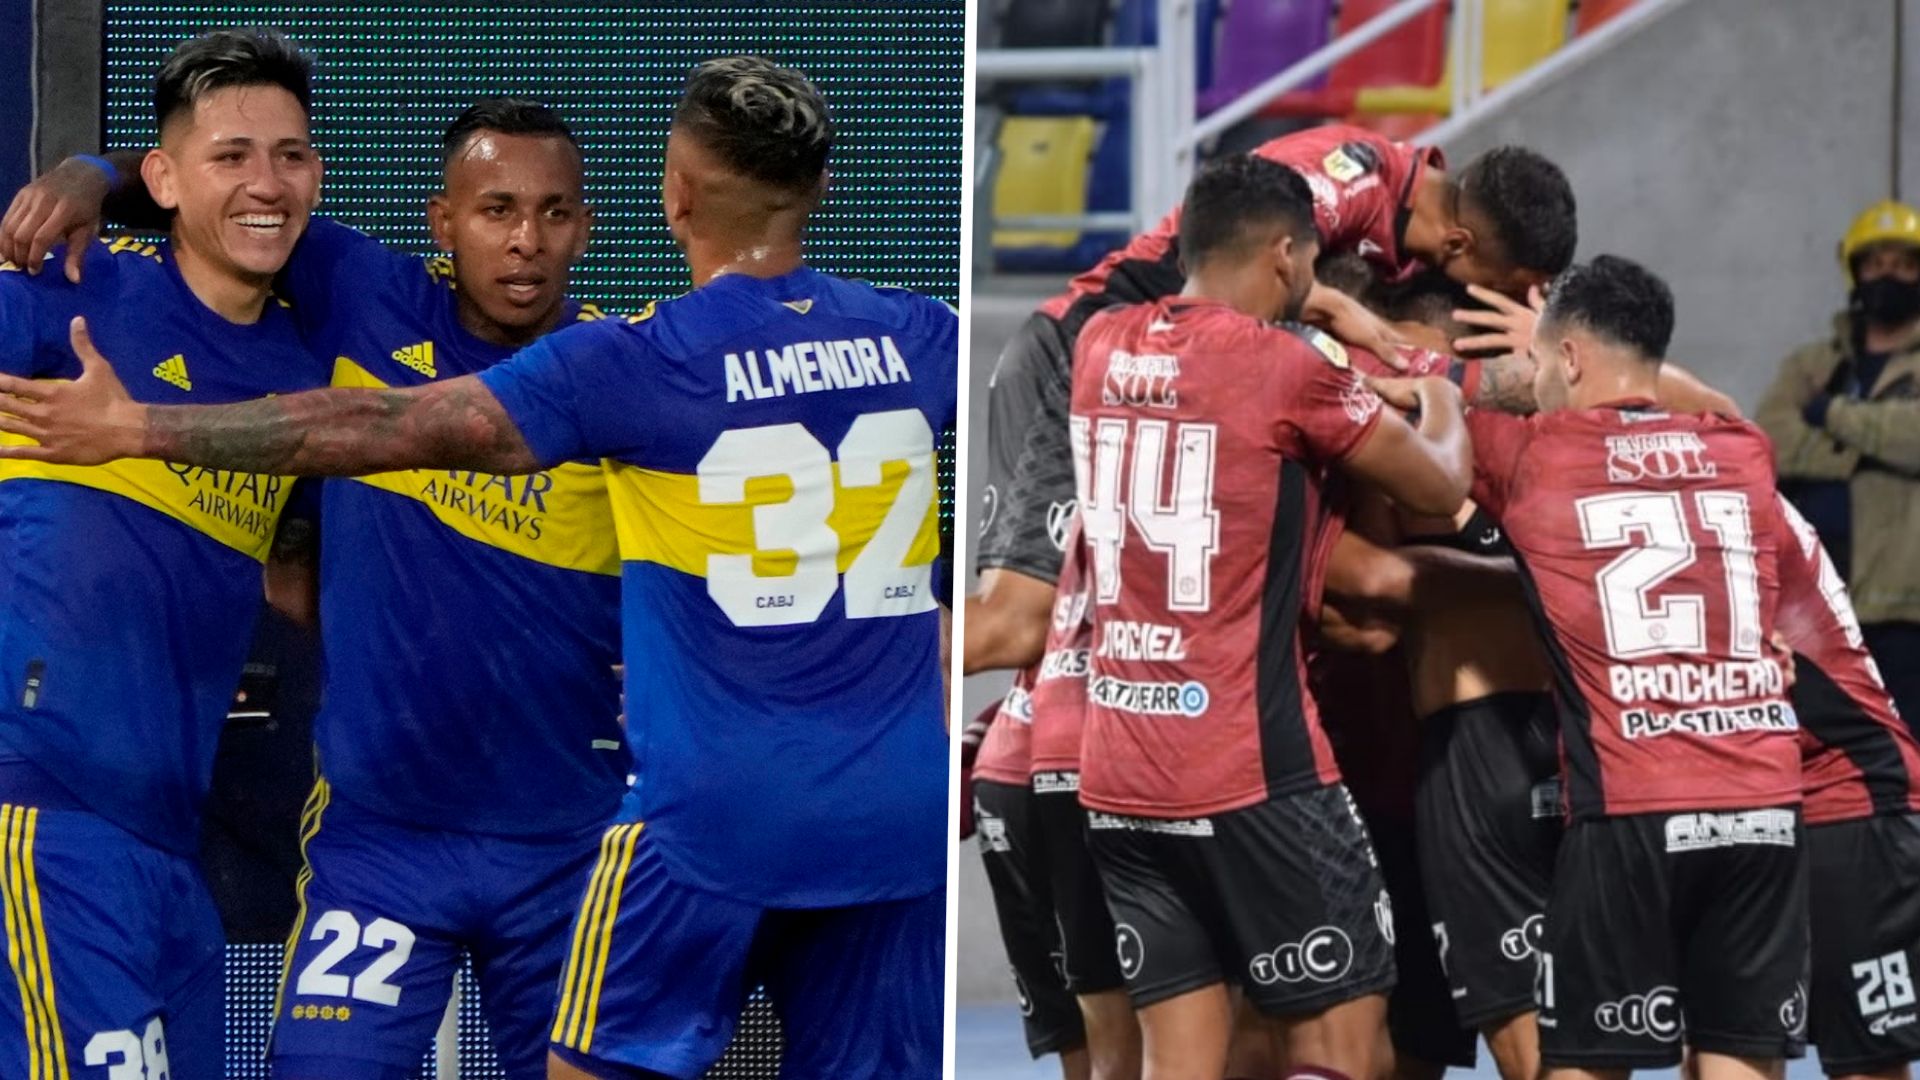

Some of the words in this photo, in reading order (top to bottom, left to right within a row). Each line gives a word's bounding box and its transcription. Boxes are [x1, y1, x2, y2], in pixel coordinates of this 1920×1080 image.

[152, 365, 193, 392] adidas
[391, 350, 438, 379] adidas
[724, 335, 911, 402] ALMENDRA
[412, 468, 553, 514] TAR
[1608, 450, 1717, 483] SOL
[188, 489, 272, 541] AIRWAYS
[420, 478, 545, 541] AIRWAYS
[696, 407, 939, 627] 32
[1070, 414, 1220, 612] 44
[1574, 490, 1761, 659] 21
[1609, 659, 1783, 703] BROCHERO
[296, 910, 416, 1006] 22
[1252, 930, 1346, 982] TIC
[1851, 949, 1917, 1016] 28
[1597, 990, 1679, 1038] TIC
